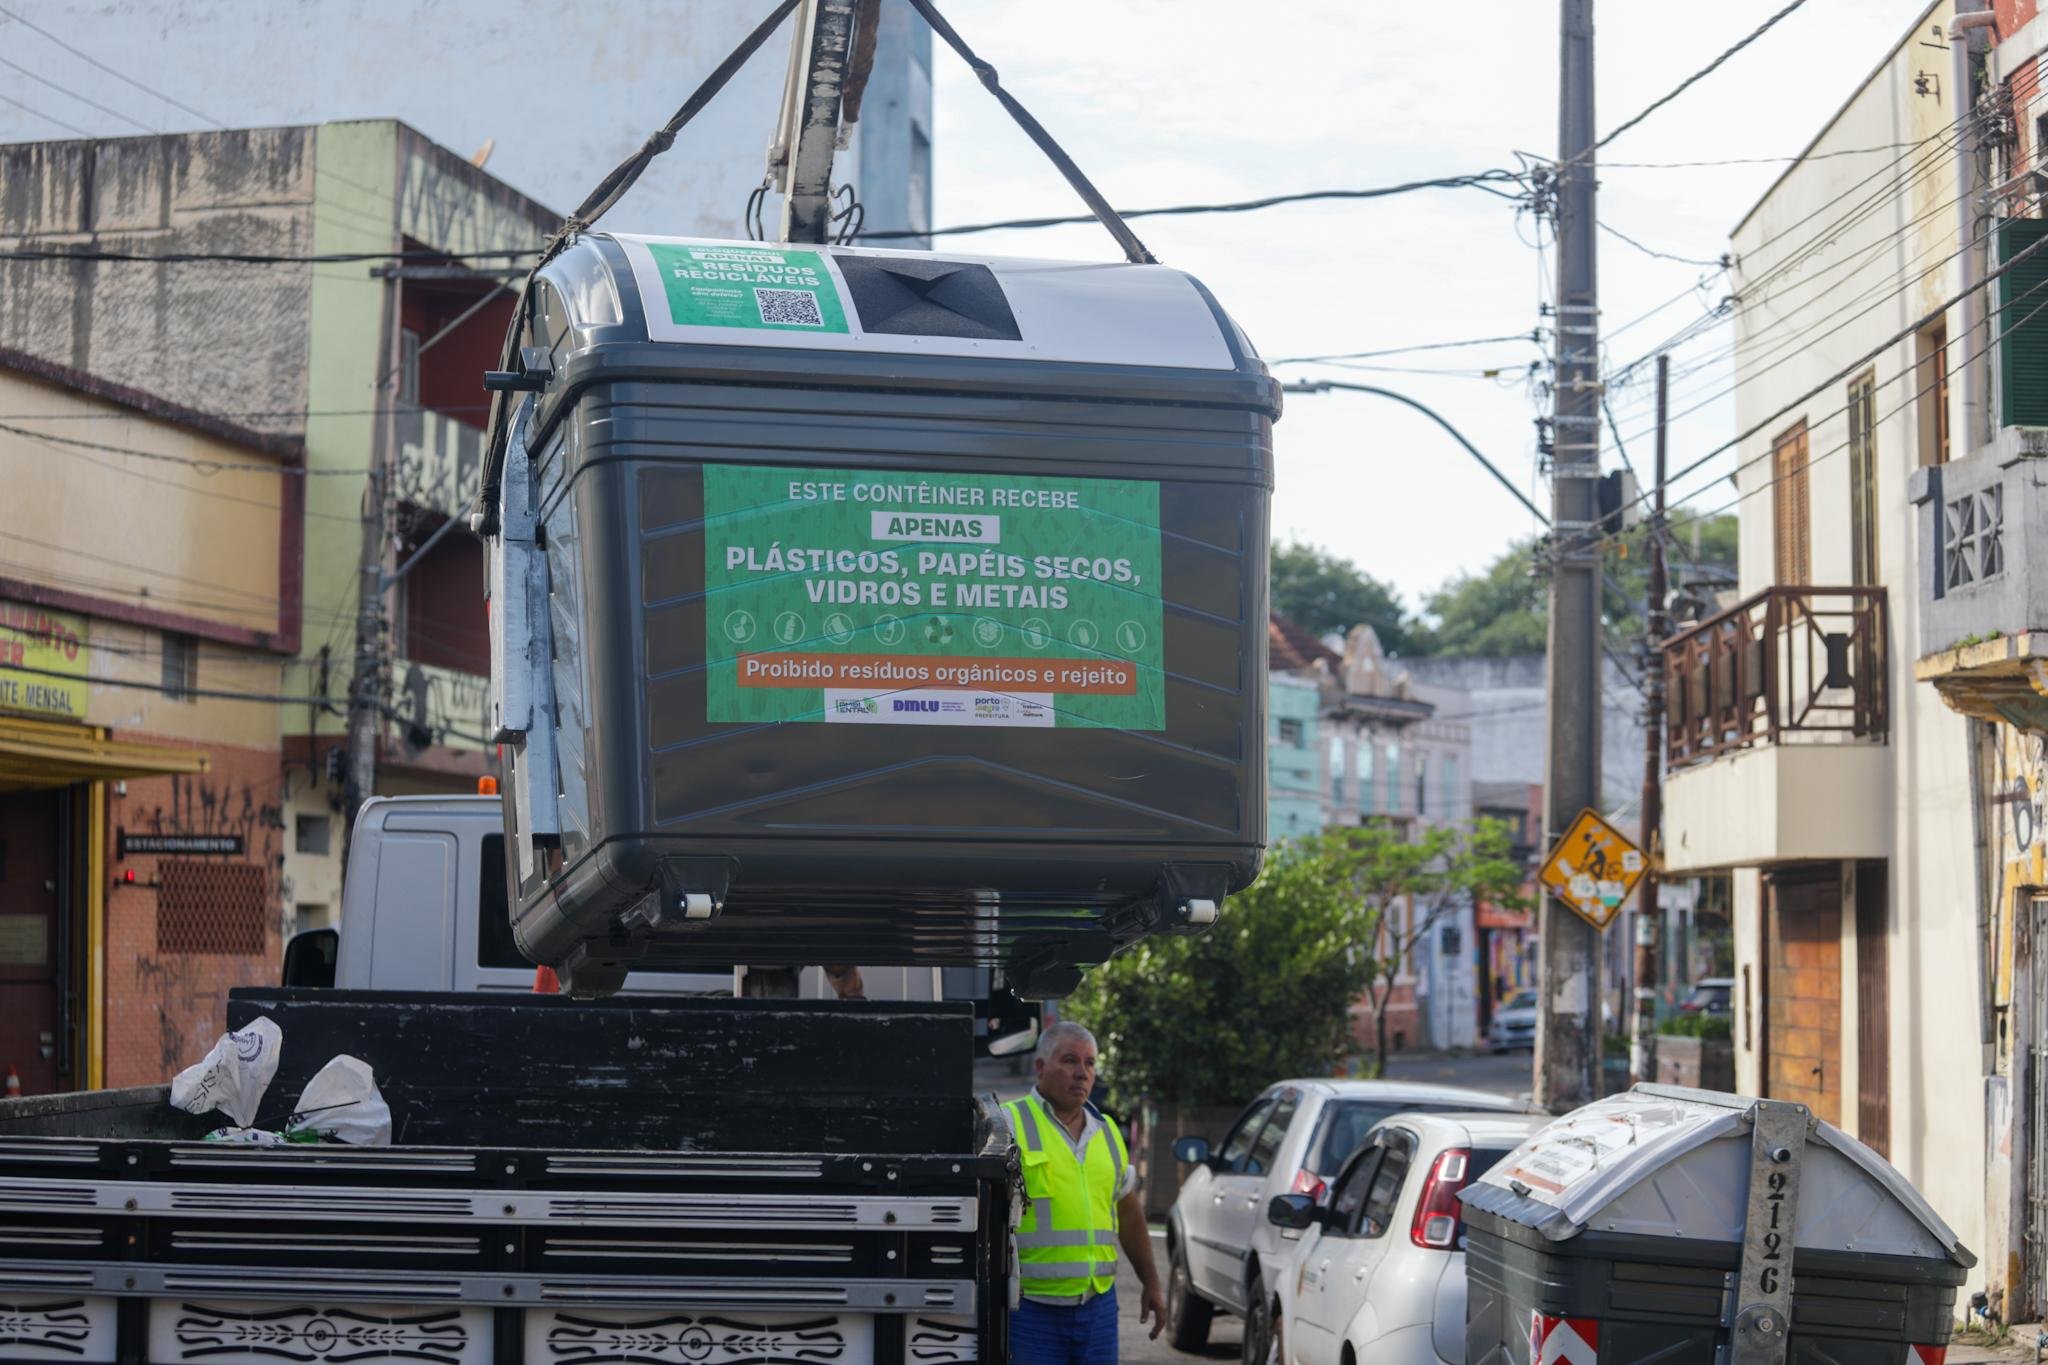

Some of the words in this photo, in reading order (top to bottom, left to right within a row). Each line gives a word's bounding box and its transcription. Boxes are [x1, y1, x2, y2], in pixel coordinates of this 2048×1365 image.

[704, 252, 774, 262] APENAS
[673, 269, 820, 287] RECICLÁVEIS
[702, 261, 816, 276] RESÍDUOS
[788, 481, 847, 502] ESTE
[852, 481, 984, 507] CONTÊINER
[991, 488, 1080, 510] RECEBE
[887, 517, 983, 538] APENAS
[726, 542, 909, 579] PLÁSTICOS,
[918, 549, 1025, 580] PAPÉIS
[1033, 556, 1142, 586] SECOS,
[805, 580, 921, 606] VIDROS
[931, 581, 947, 606] E
[956, 583, 1069, 610] METAIS
[746, 659, 835, 680] Proibido
[839, 662, 929, 683] resíduos
[934, 660, 1036, 690] orgânicos
[1042, 668, 1056, 684] e
[1060, 663, 1128, 689] rejeito
[26, 682, 73, 713] MENSAL
[893, 700, 939, 712] DMLU
[975, 697, 1000, 705] porto
